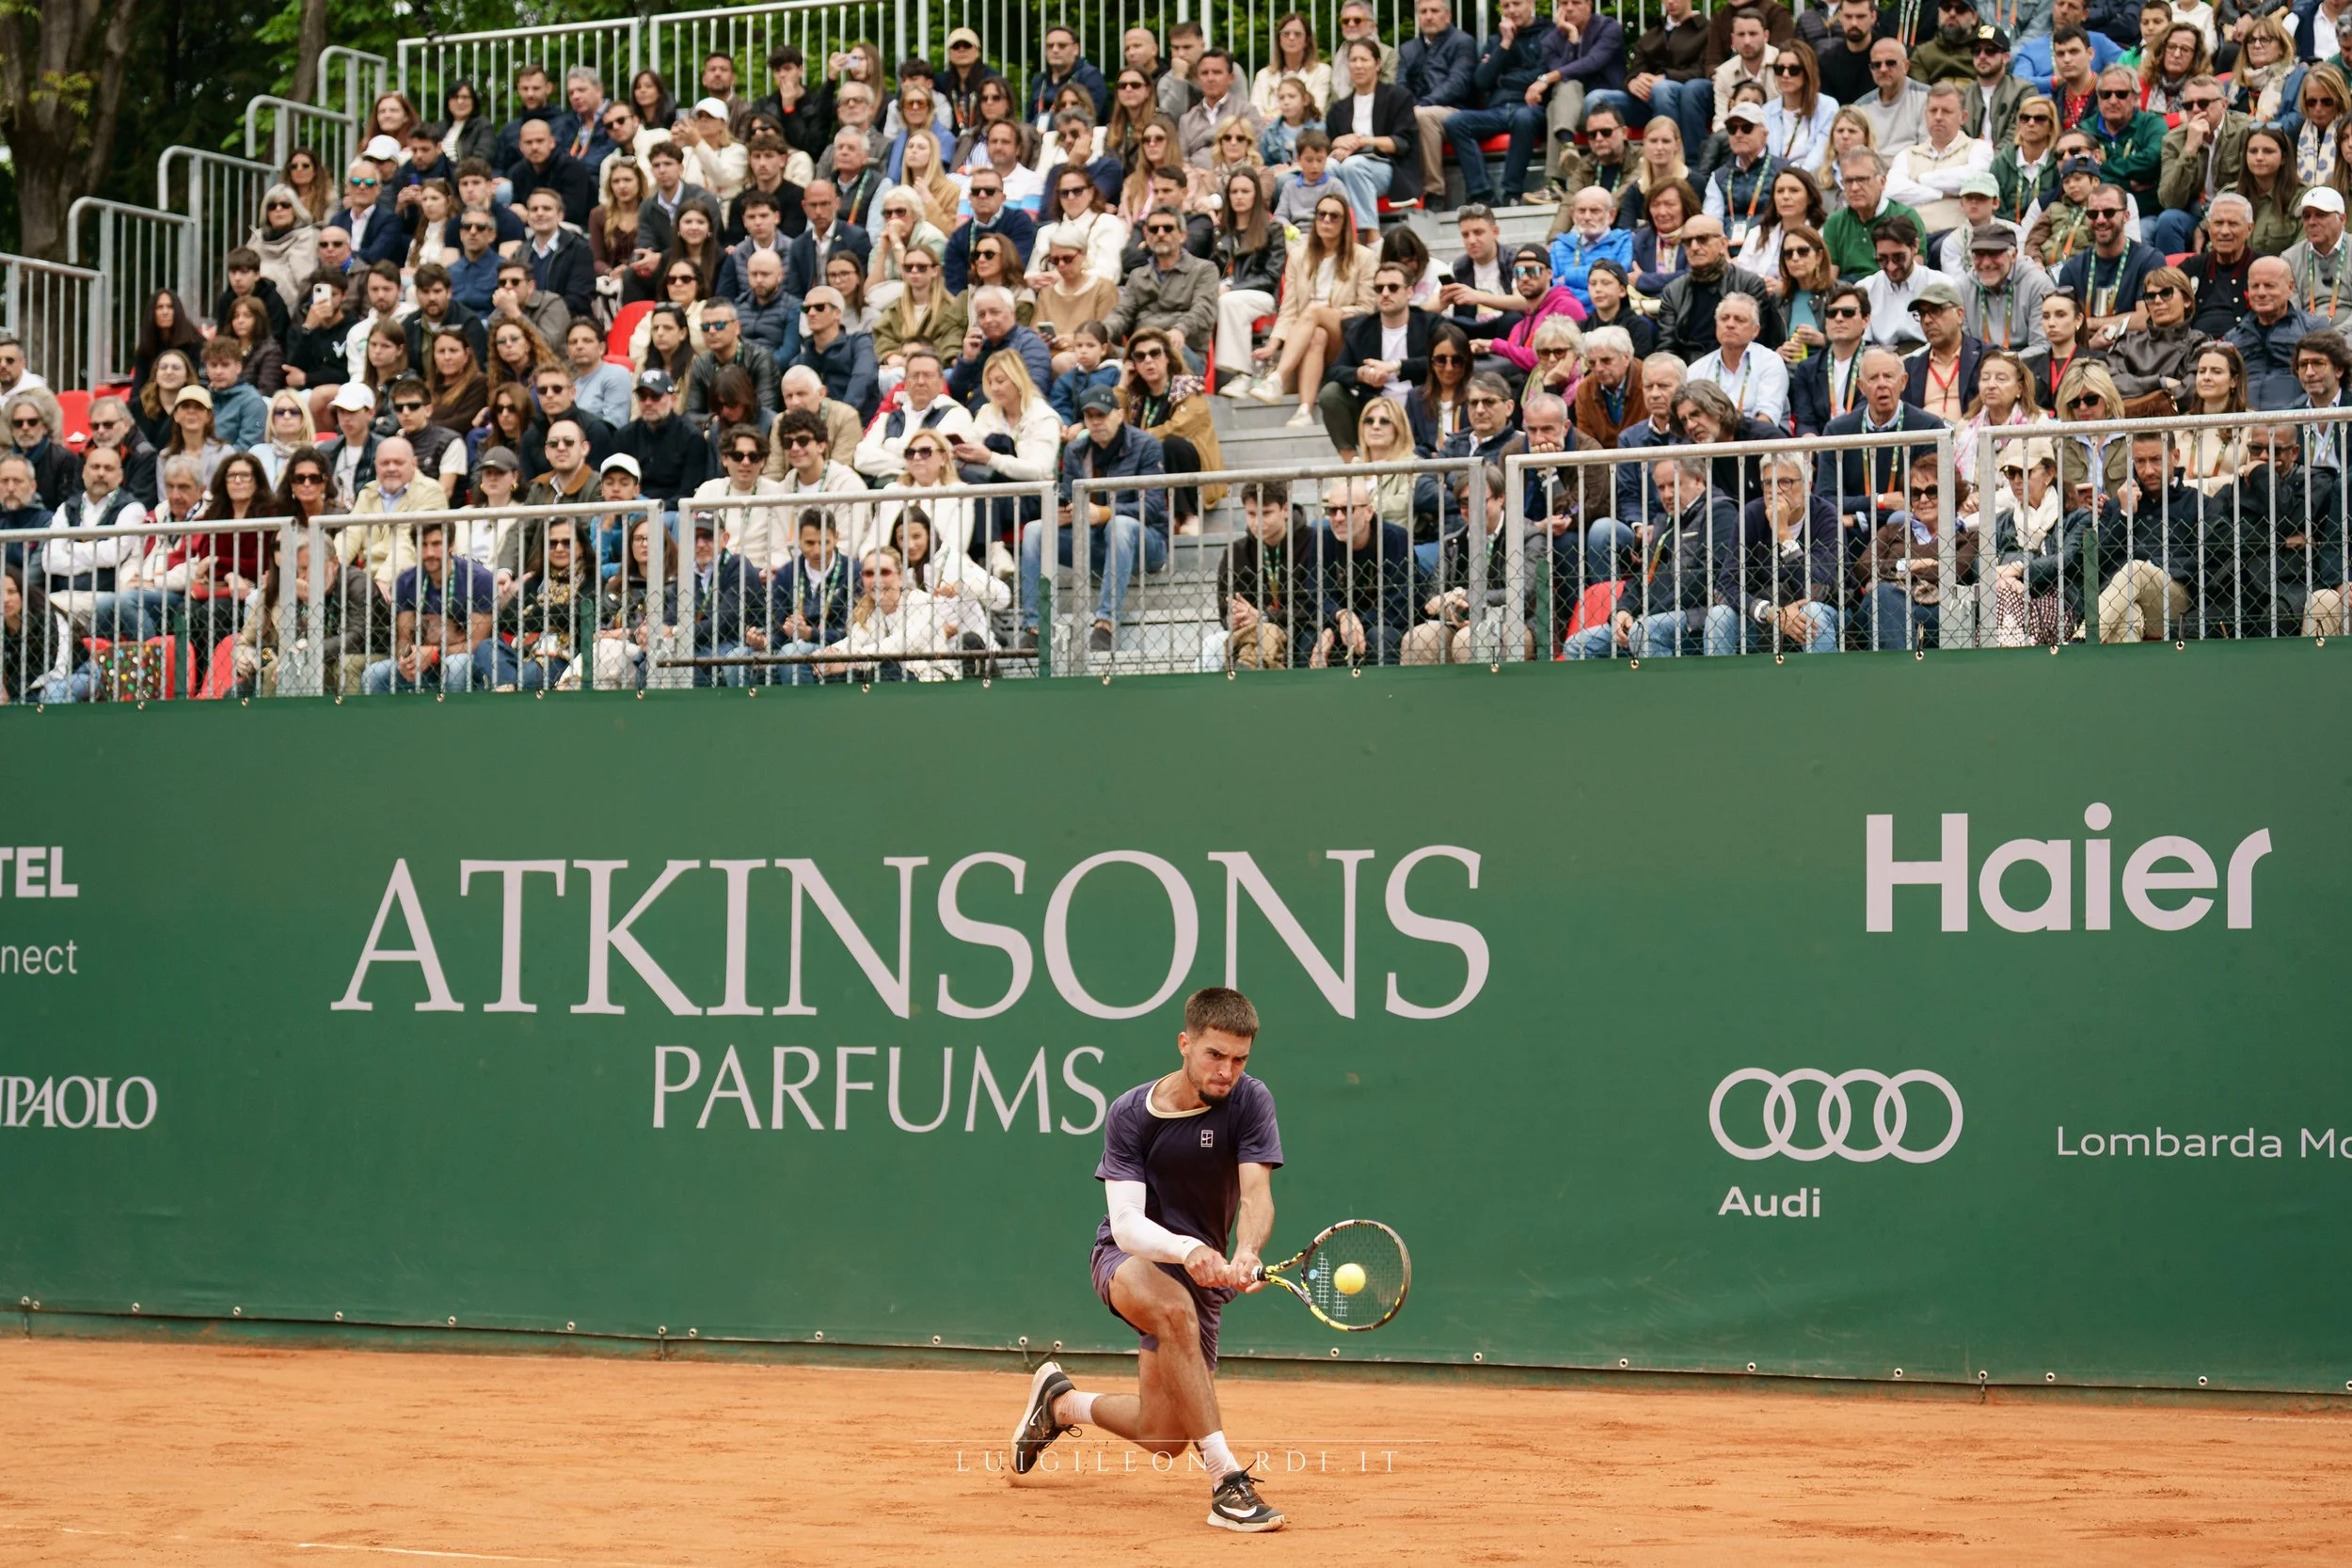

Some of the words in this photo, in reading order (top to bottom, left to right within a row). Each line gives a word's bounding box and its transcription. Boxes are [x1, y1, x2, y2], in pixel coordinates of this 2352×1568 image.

[1866, 802, 2273, 933] Haier
[1, 940, 77, 974] nect
[330, 845, 1490, 1021] ATKINSONS
[0, 1076, 157, 1130] PAOLO
[653, 1045, 1108, 1135] PARFUMS
[2058, 1126, 2282, 1158] Lombarda
[1718, 1186, 1820, 1218] Audi
